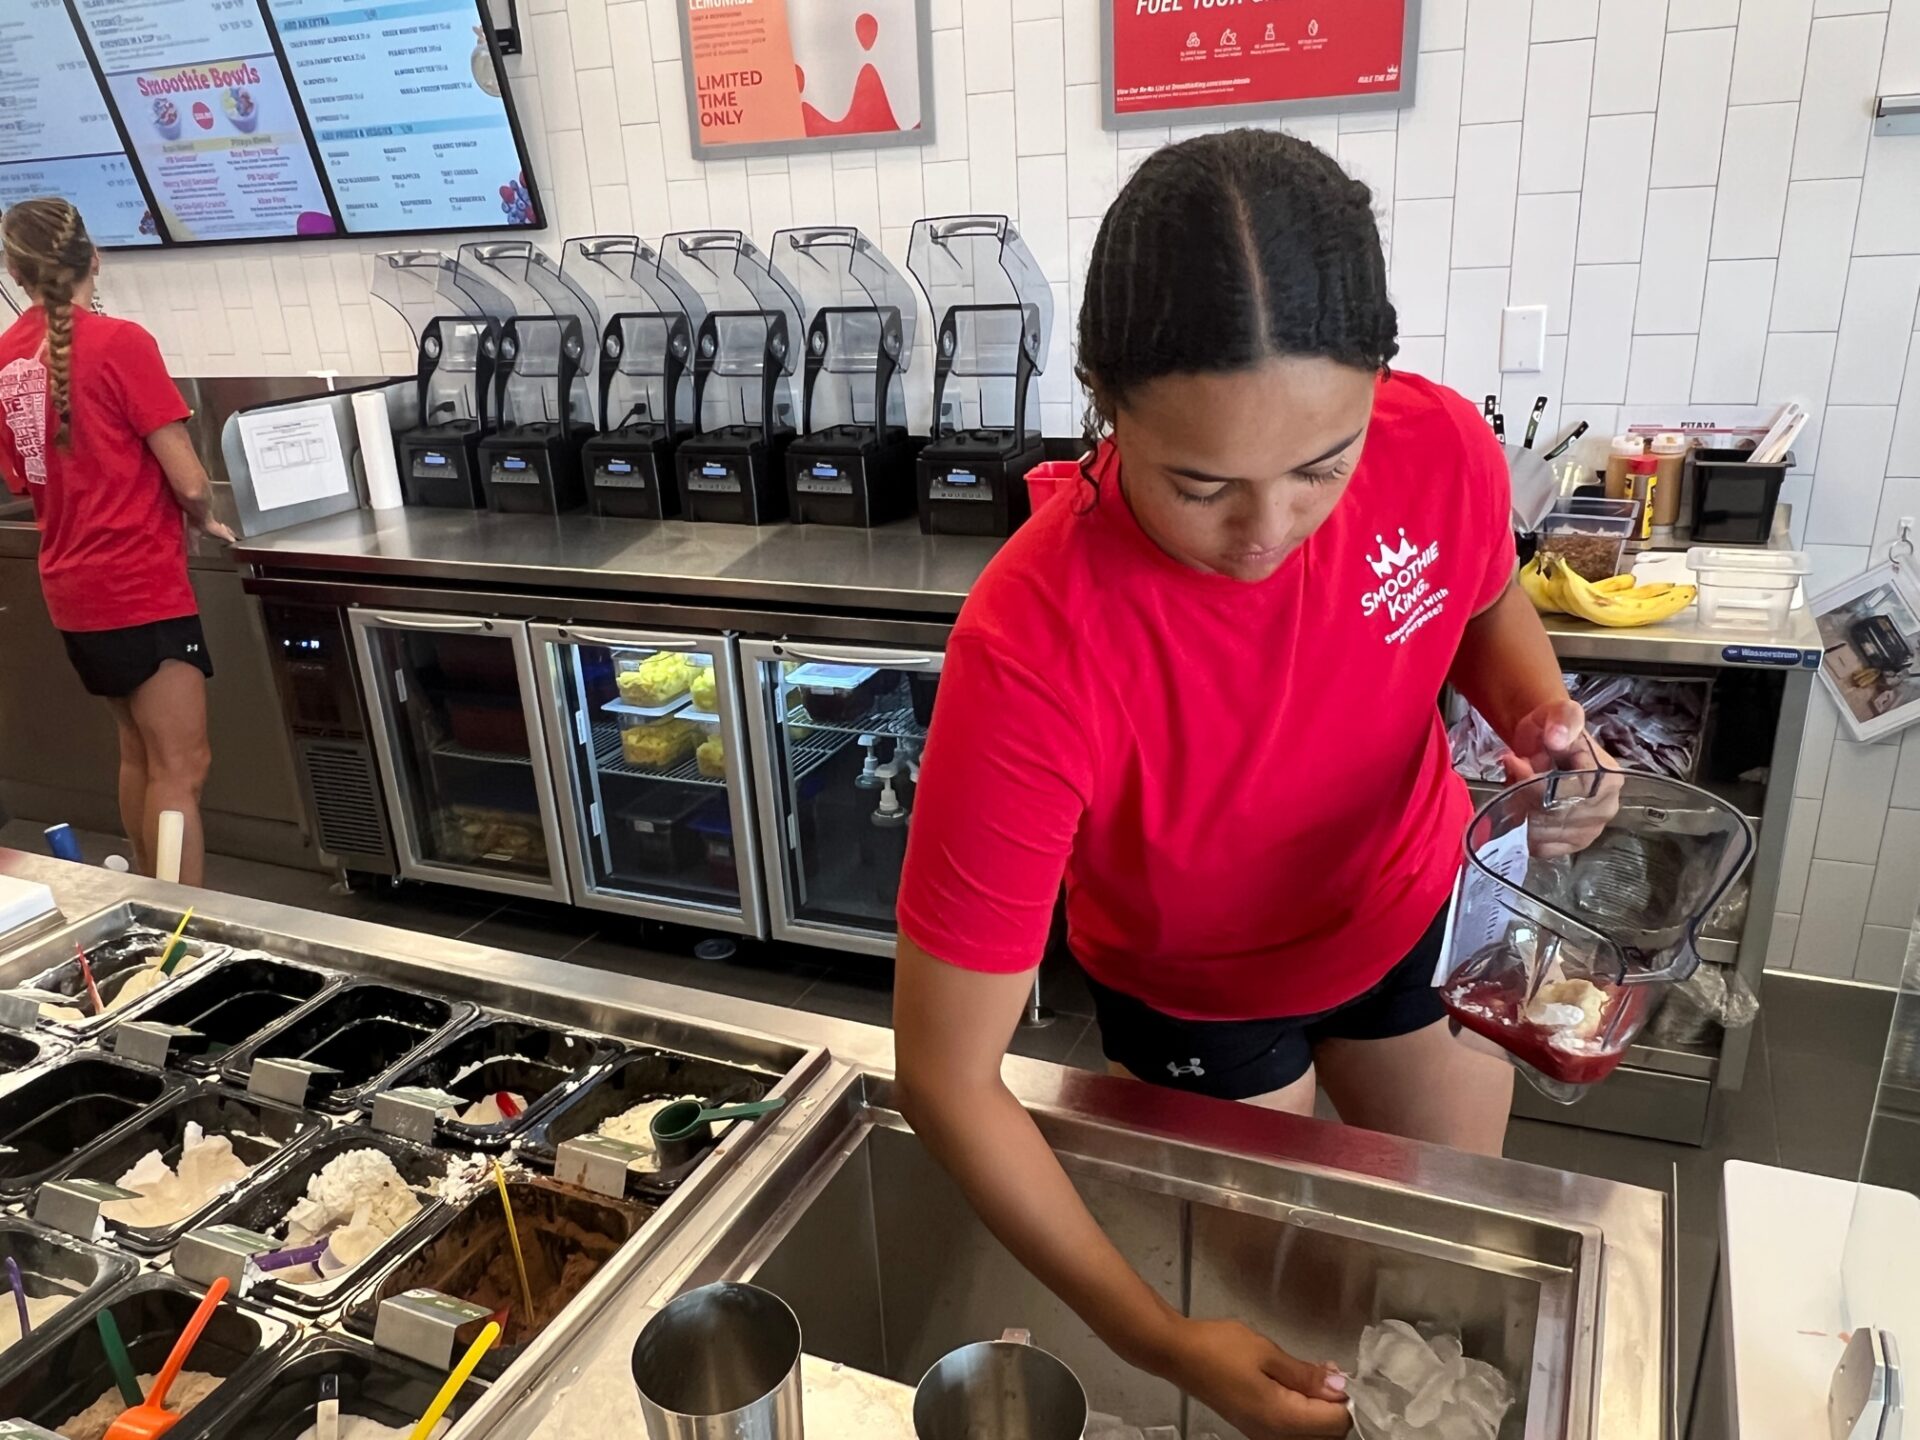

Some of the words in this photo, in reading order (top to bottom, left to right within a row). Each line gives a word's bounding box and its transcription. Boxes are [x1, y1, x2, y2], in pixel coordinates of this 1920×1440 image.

[136, 68, 211, 97] Smoothie
[208, 62, 261, 89] Bowls
[697, 70, 763, 91] LIMITED
[698, 91, 738, 110] TIME
[700, 109, 744, 127] ONLY
[1361, 540, 1439, 616] SMOOTHIE
[1741, 647, 1798, 659] Wasserstrom
